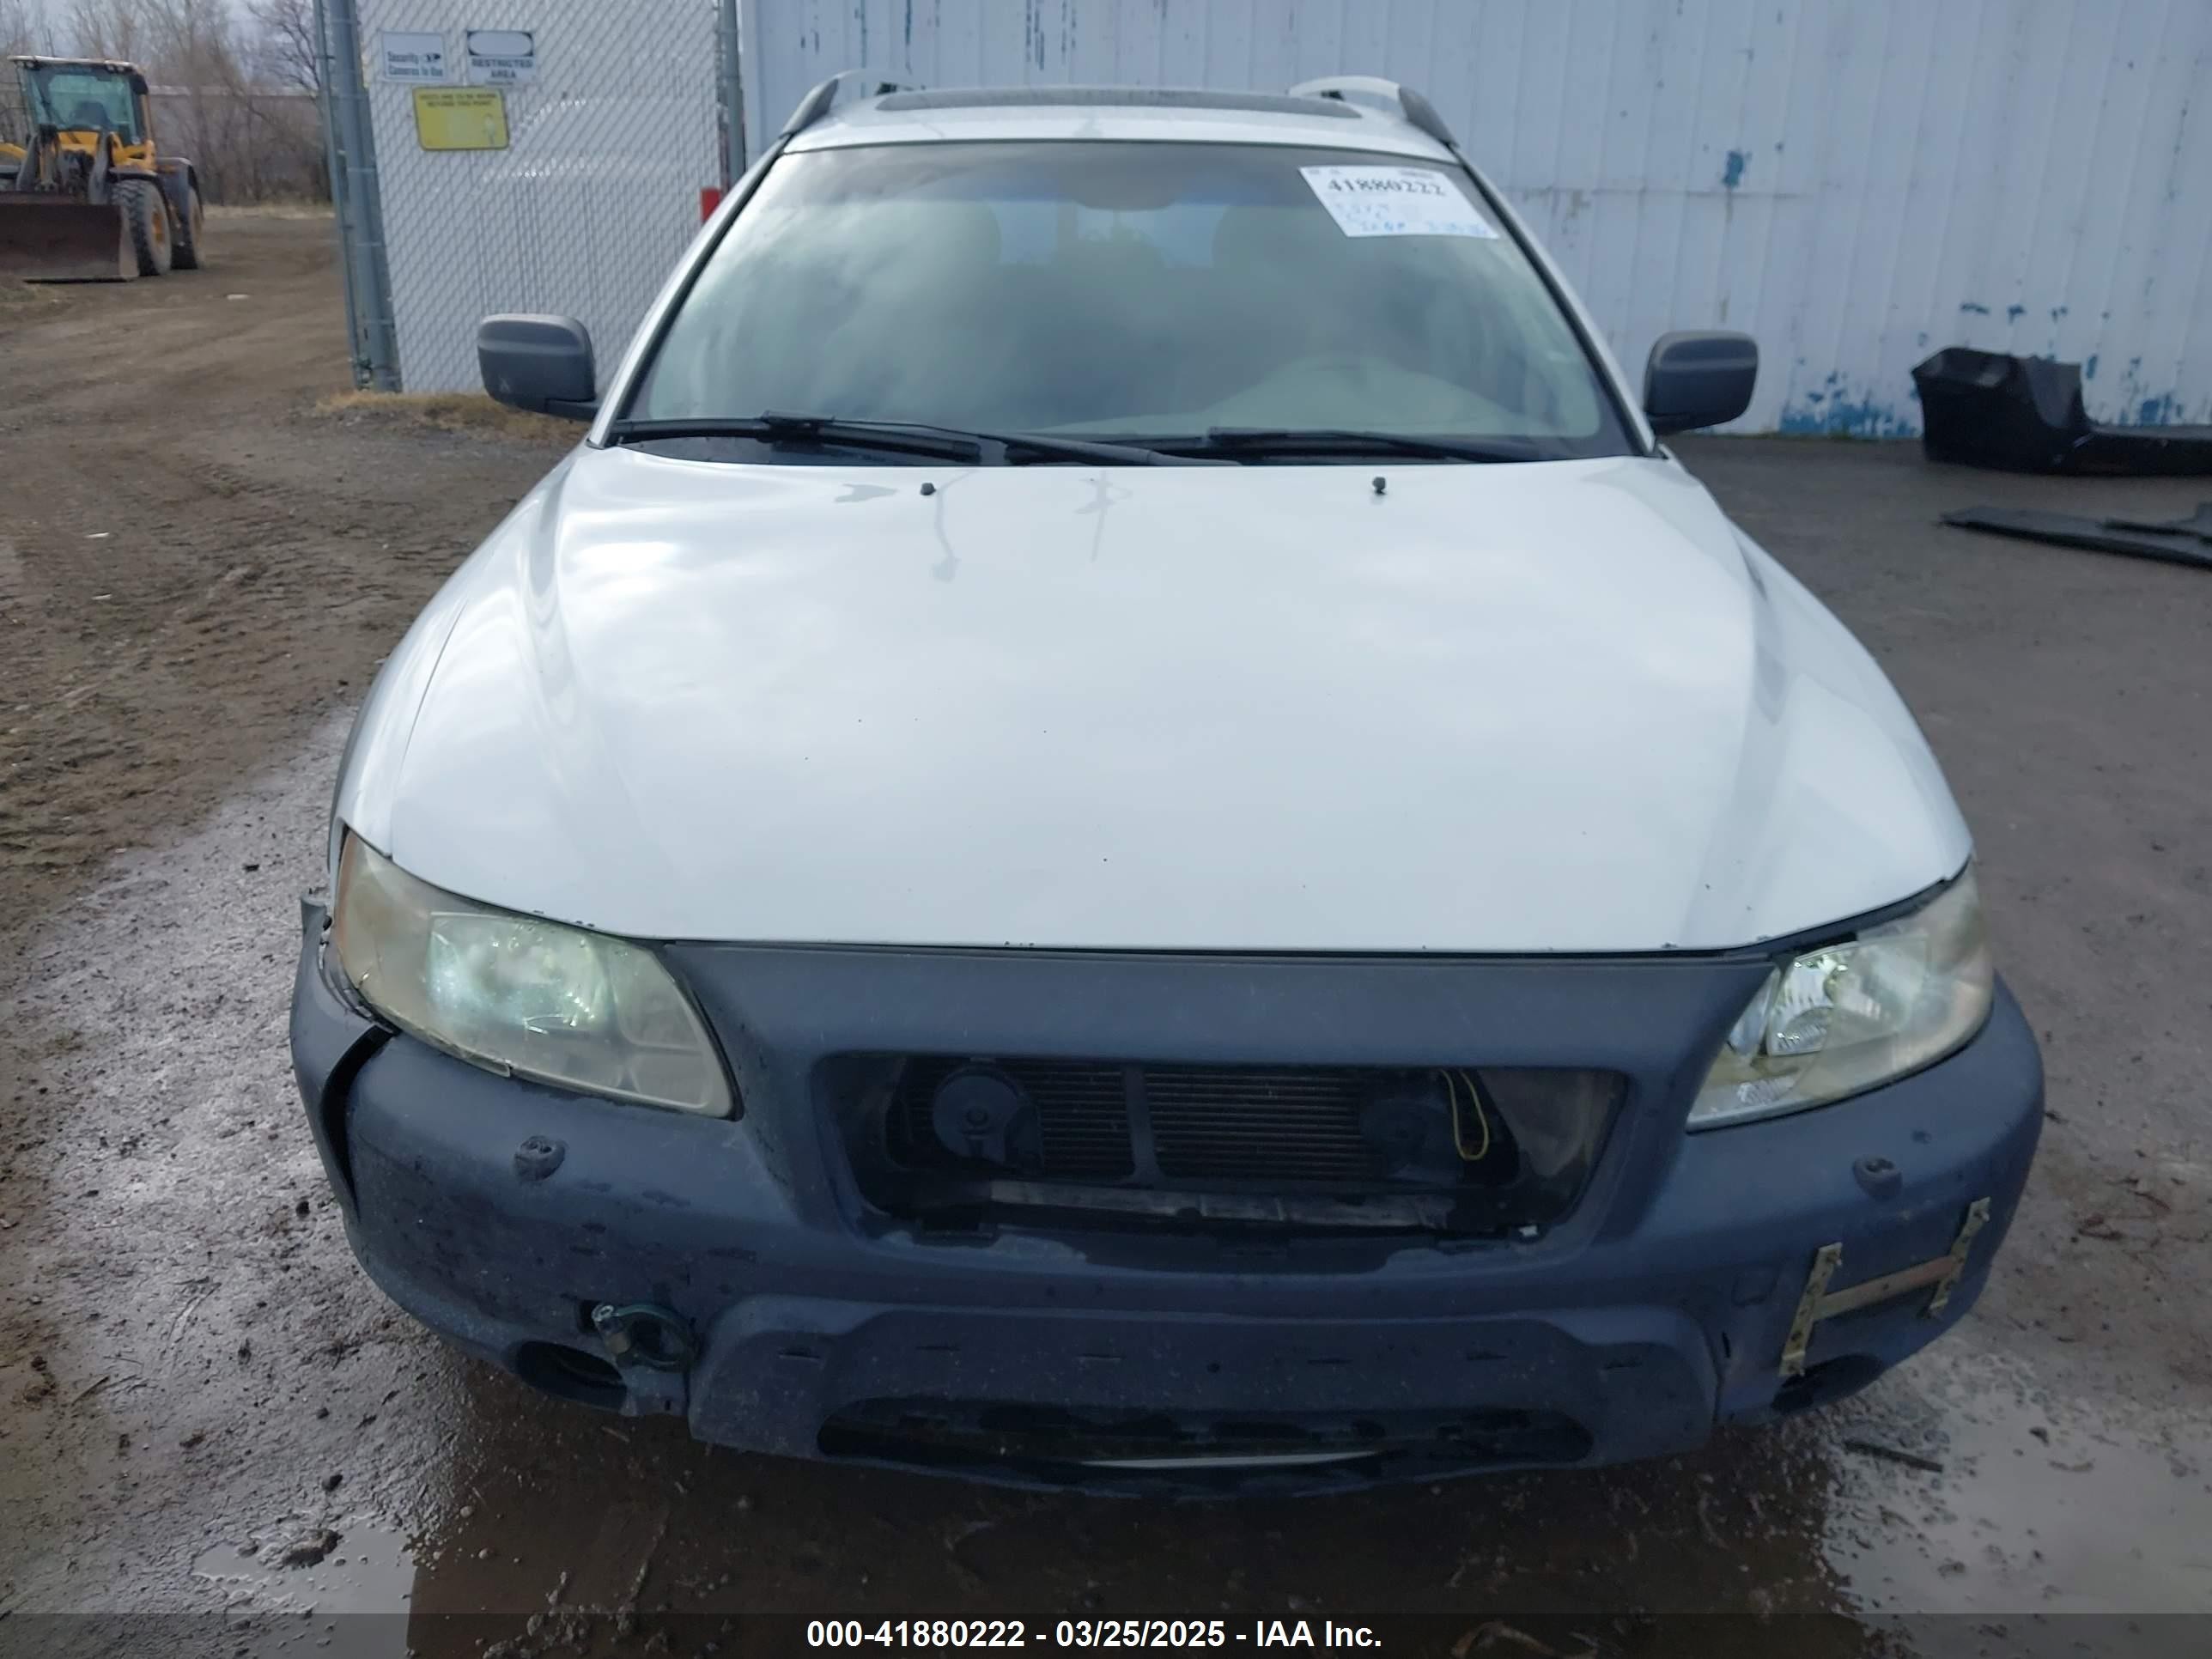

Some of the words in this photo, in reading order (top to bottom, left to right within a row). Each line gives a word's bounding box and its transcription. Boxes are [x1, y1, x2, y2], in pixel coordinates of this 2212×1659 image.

[471, 58, 533, 69] RESTRICTED
[490, 70, 517, 80] AREA
[1327, 178, 1448, 198] 41880222
